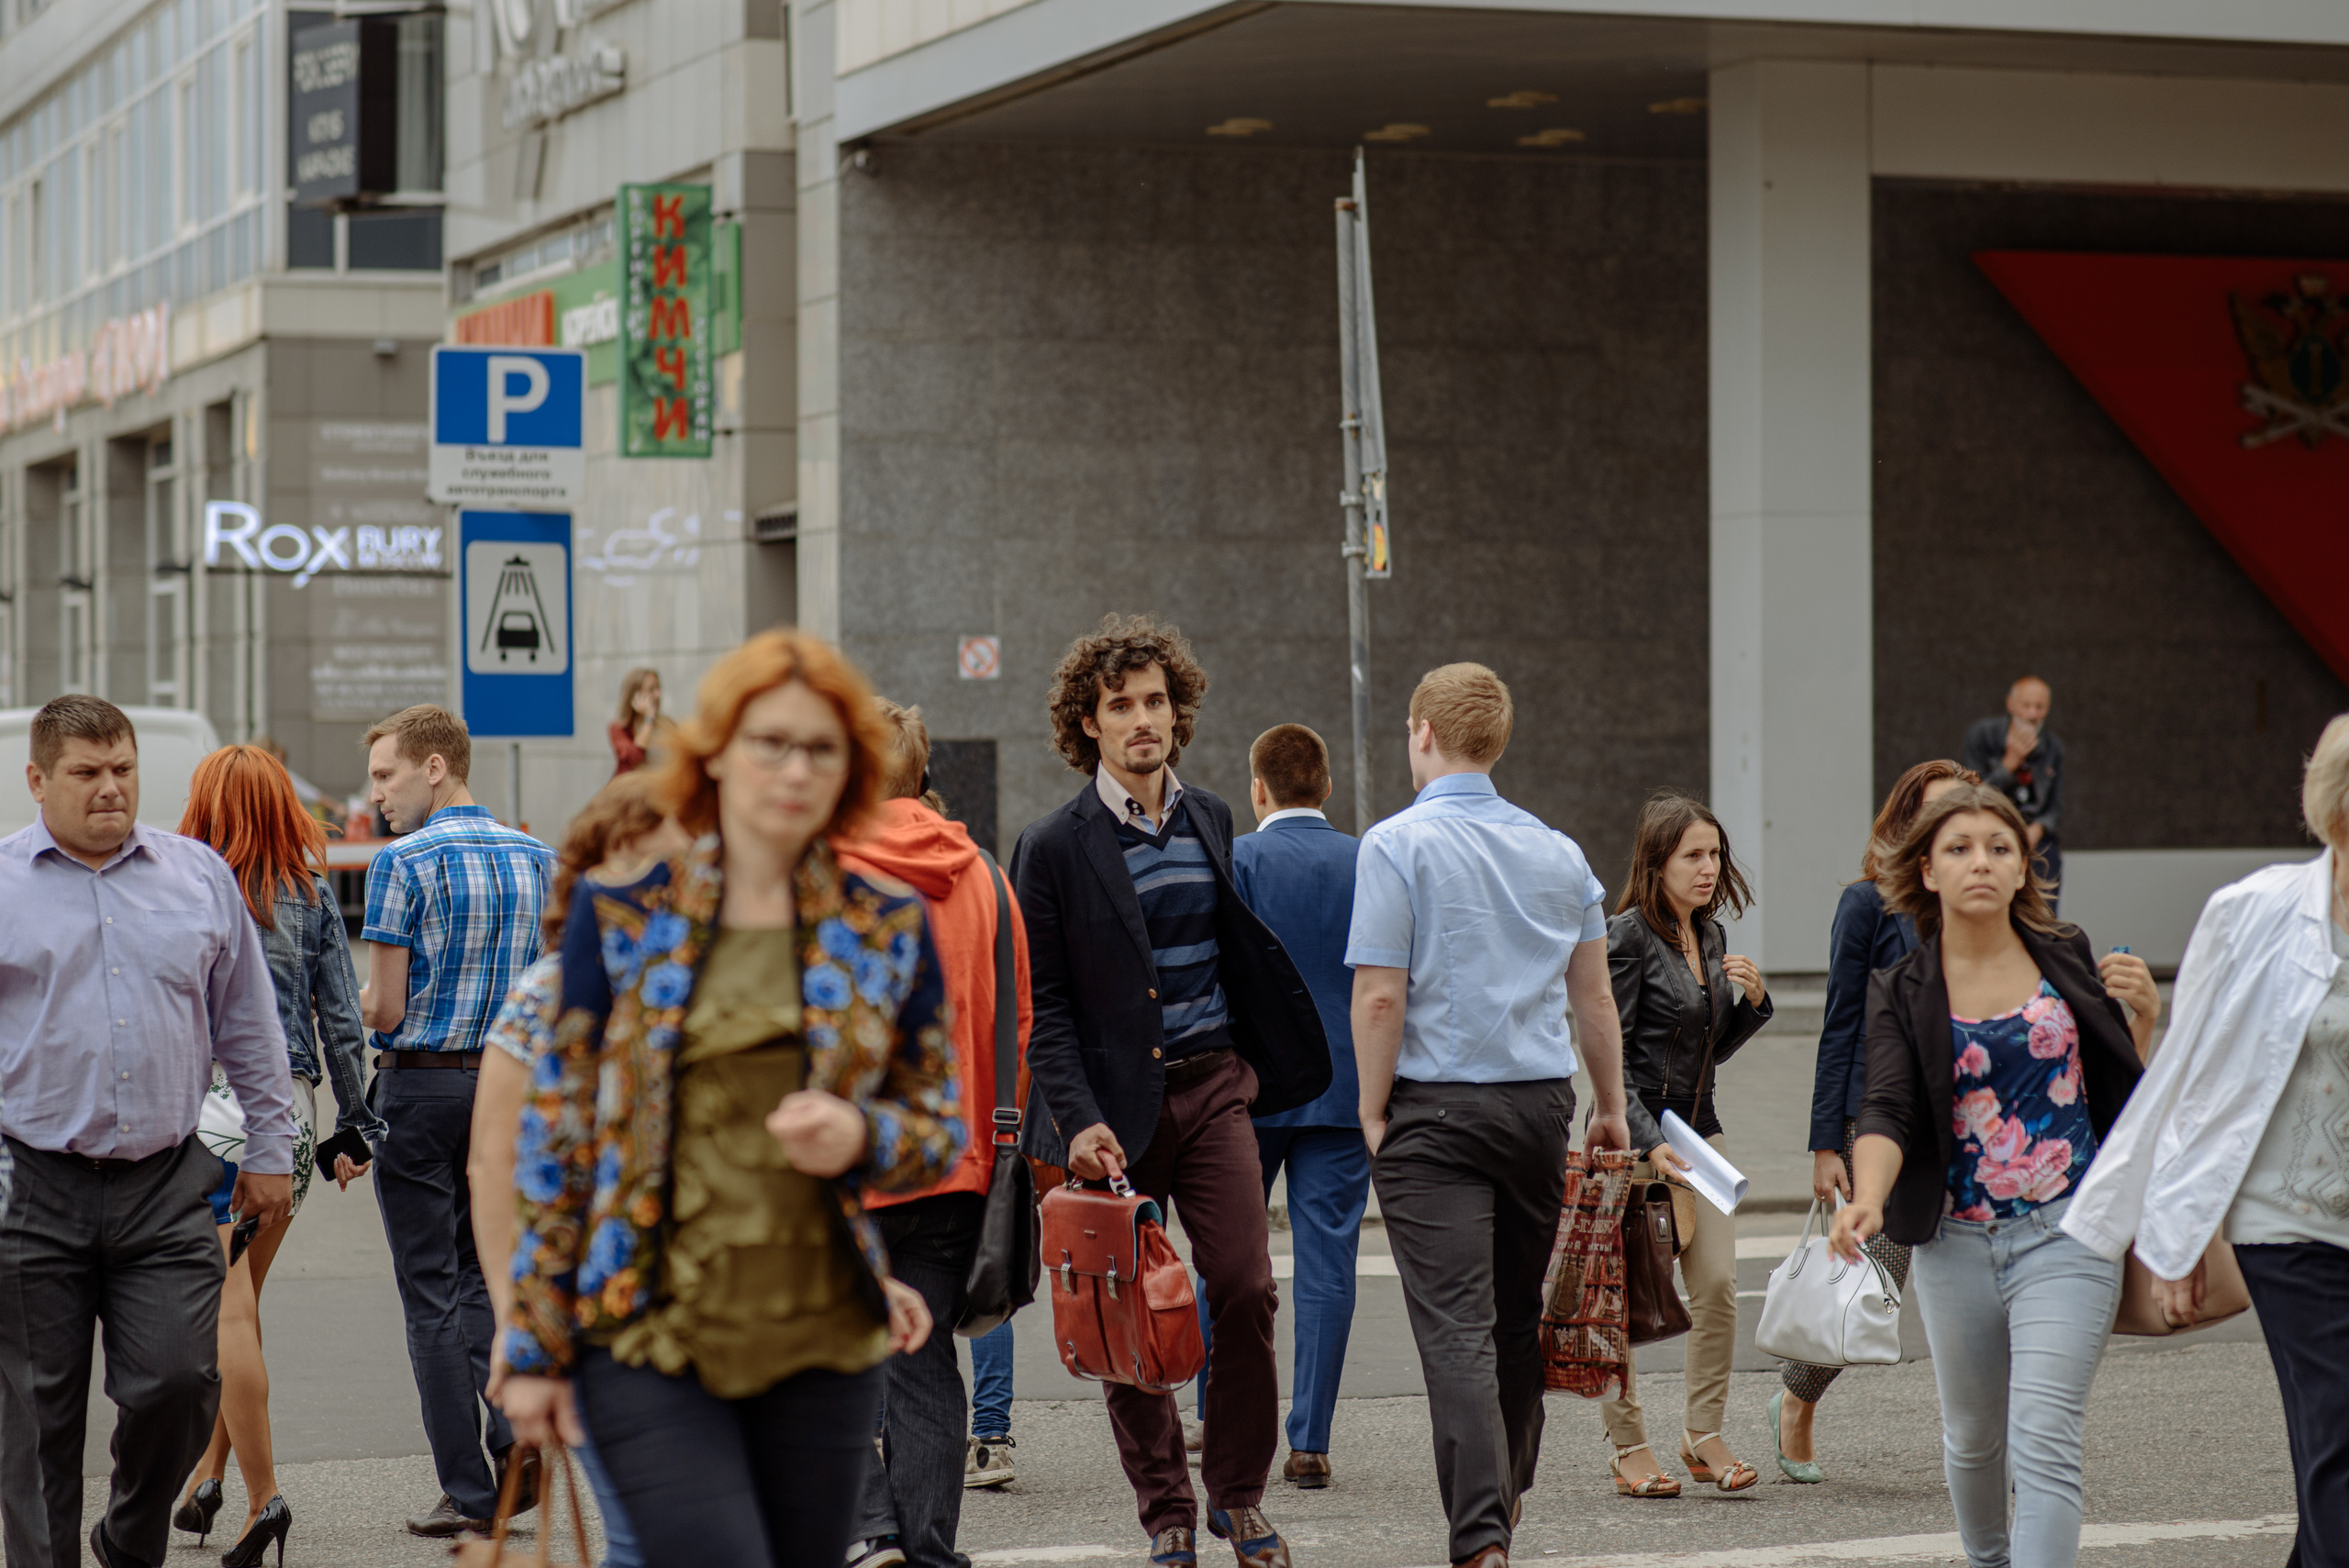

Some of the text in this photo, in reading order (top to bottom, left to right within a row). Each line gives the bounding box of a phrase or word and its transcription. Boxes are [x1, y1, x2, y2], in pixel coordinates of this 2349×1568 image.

[649, 194, 690, 440] КИМЧИ
[487, 355, 551, 444] P
[465, 448, 549, 463] Въезд для
[462, 467, 551, 480] служебного
[446, 484, 566, 498] автотранспорта
